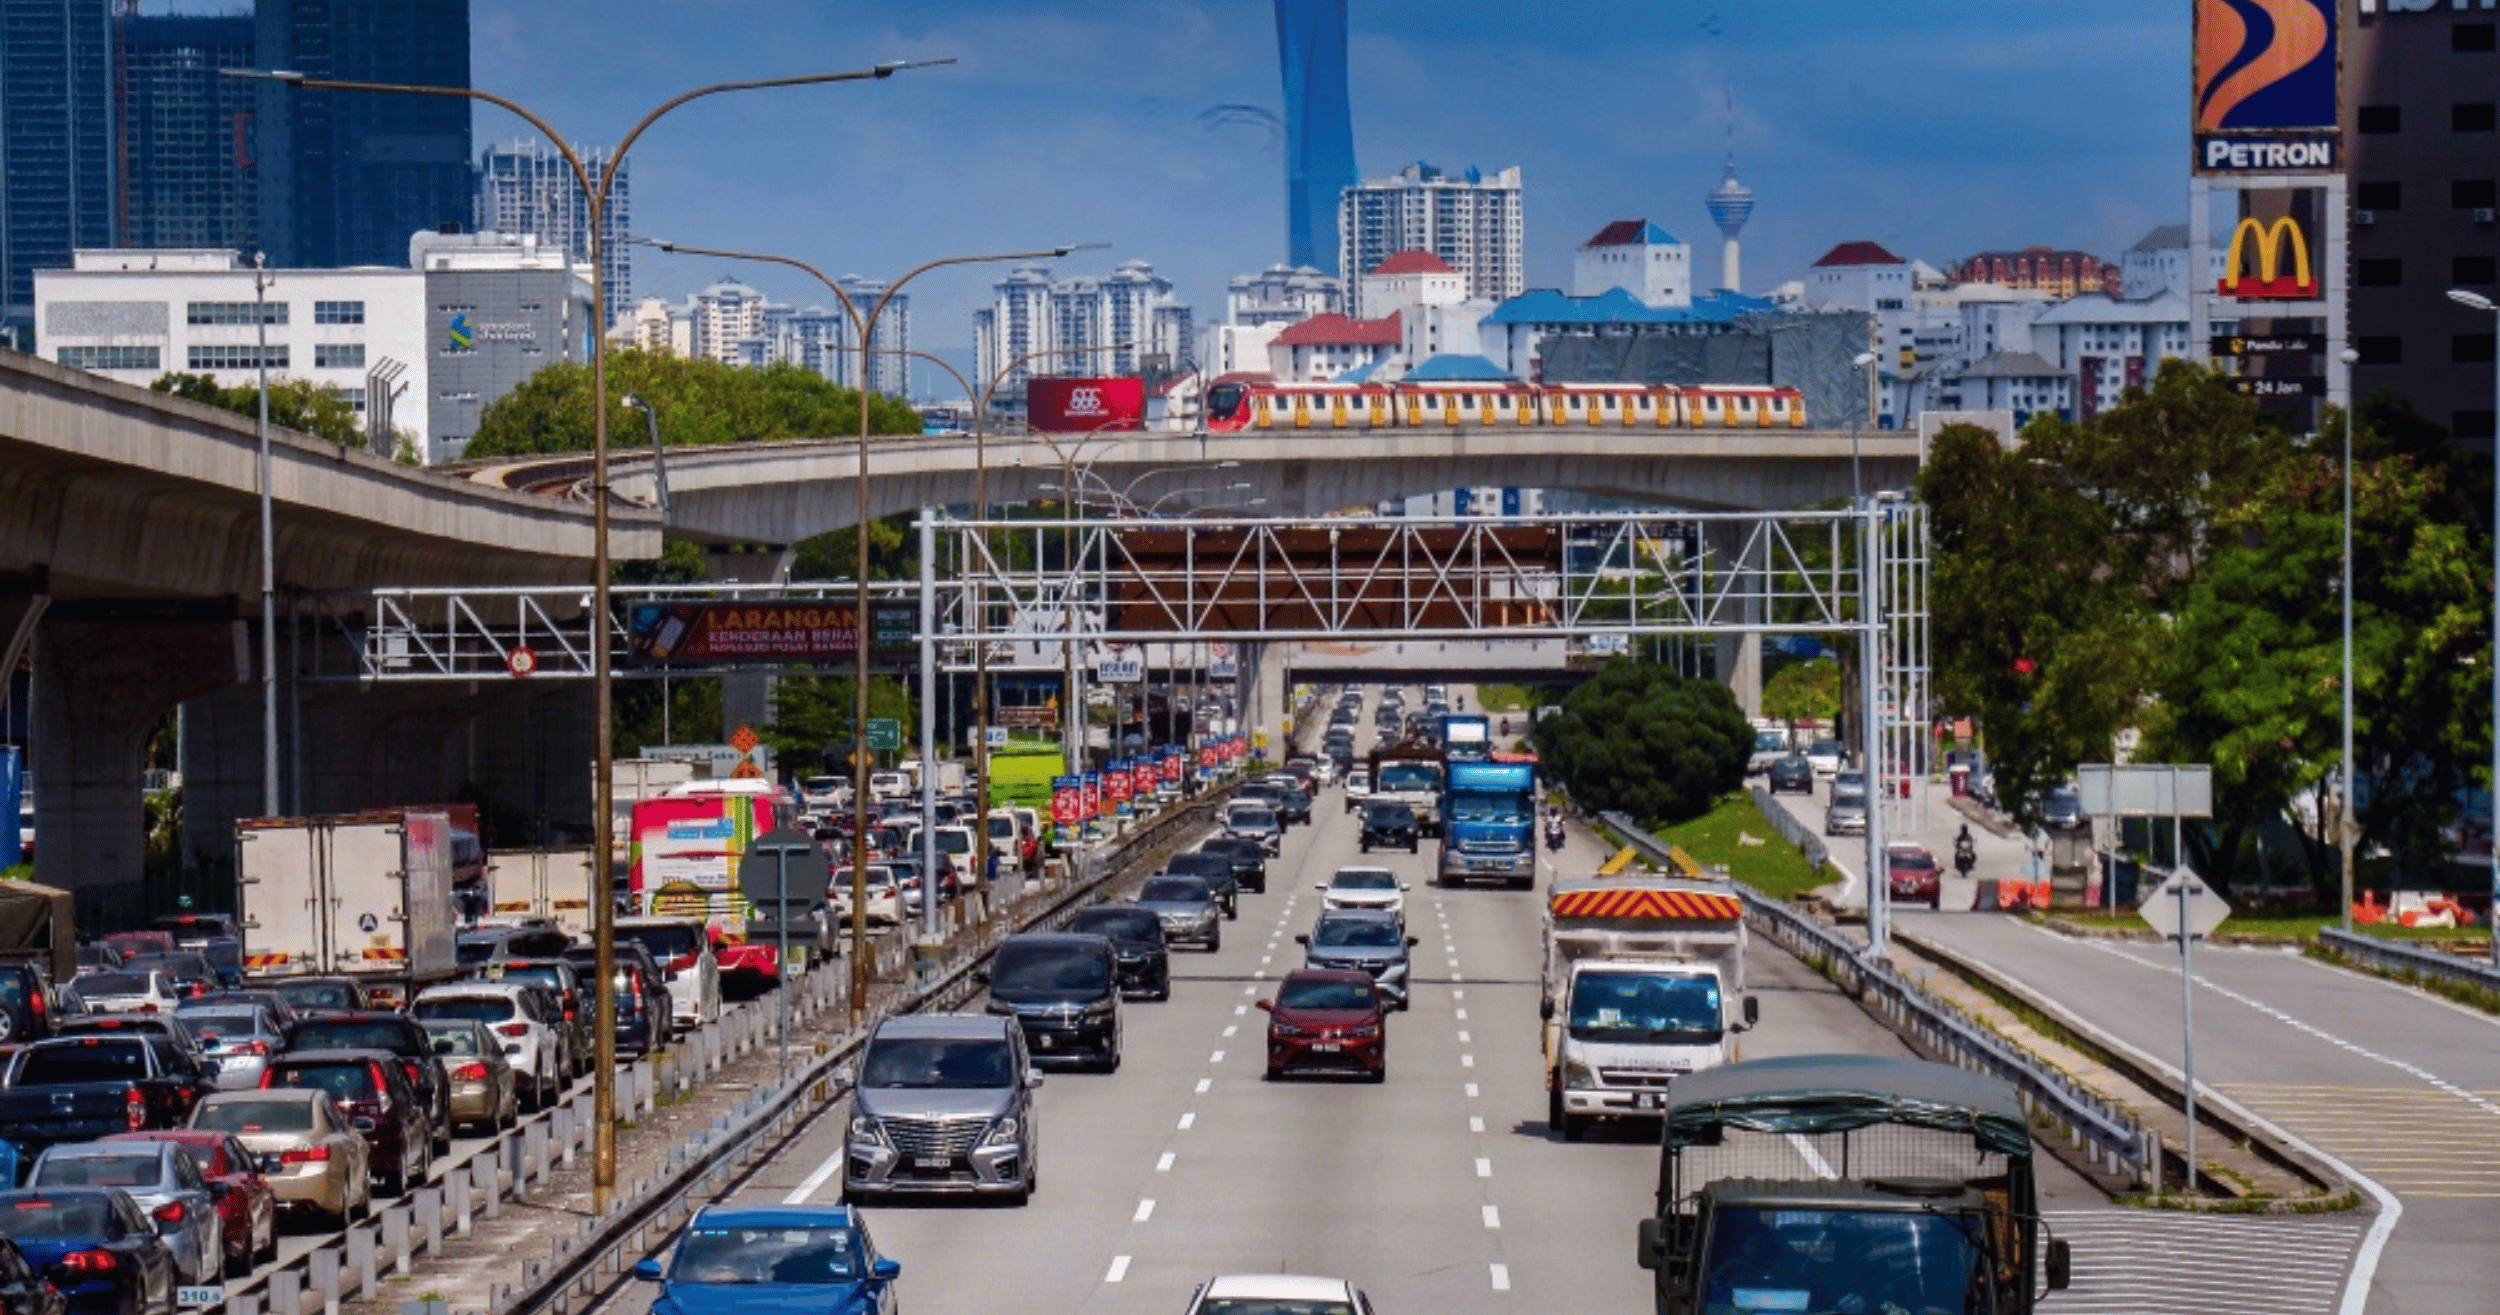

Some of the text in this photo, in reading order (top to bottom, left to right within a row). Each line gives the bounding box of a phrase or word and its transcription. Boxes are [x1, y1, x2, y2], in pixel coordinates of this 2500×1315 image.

[2207, 141, 2329, 166] PETRON
[2254, 381, 2273, 394] 24
[707, 609, 859, 629] LARANGAN
